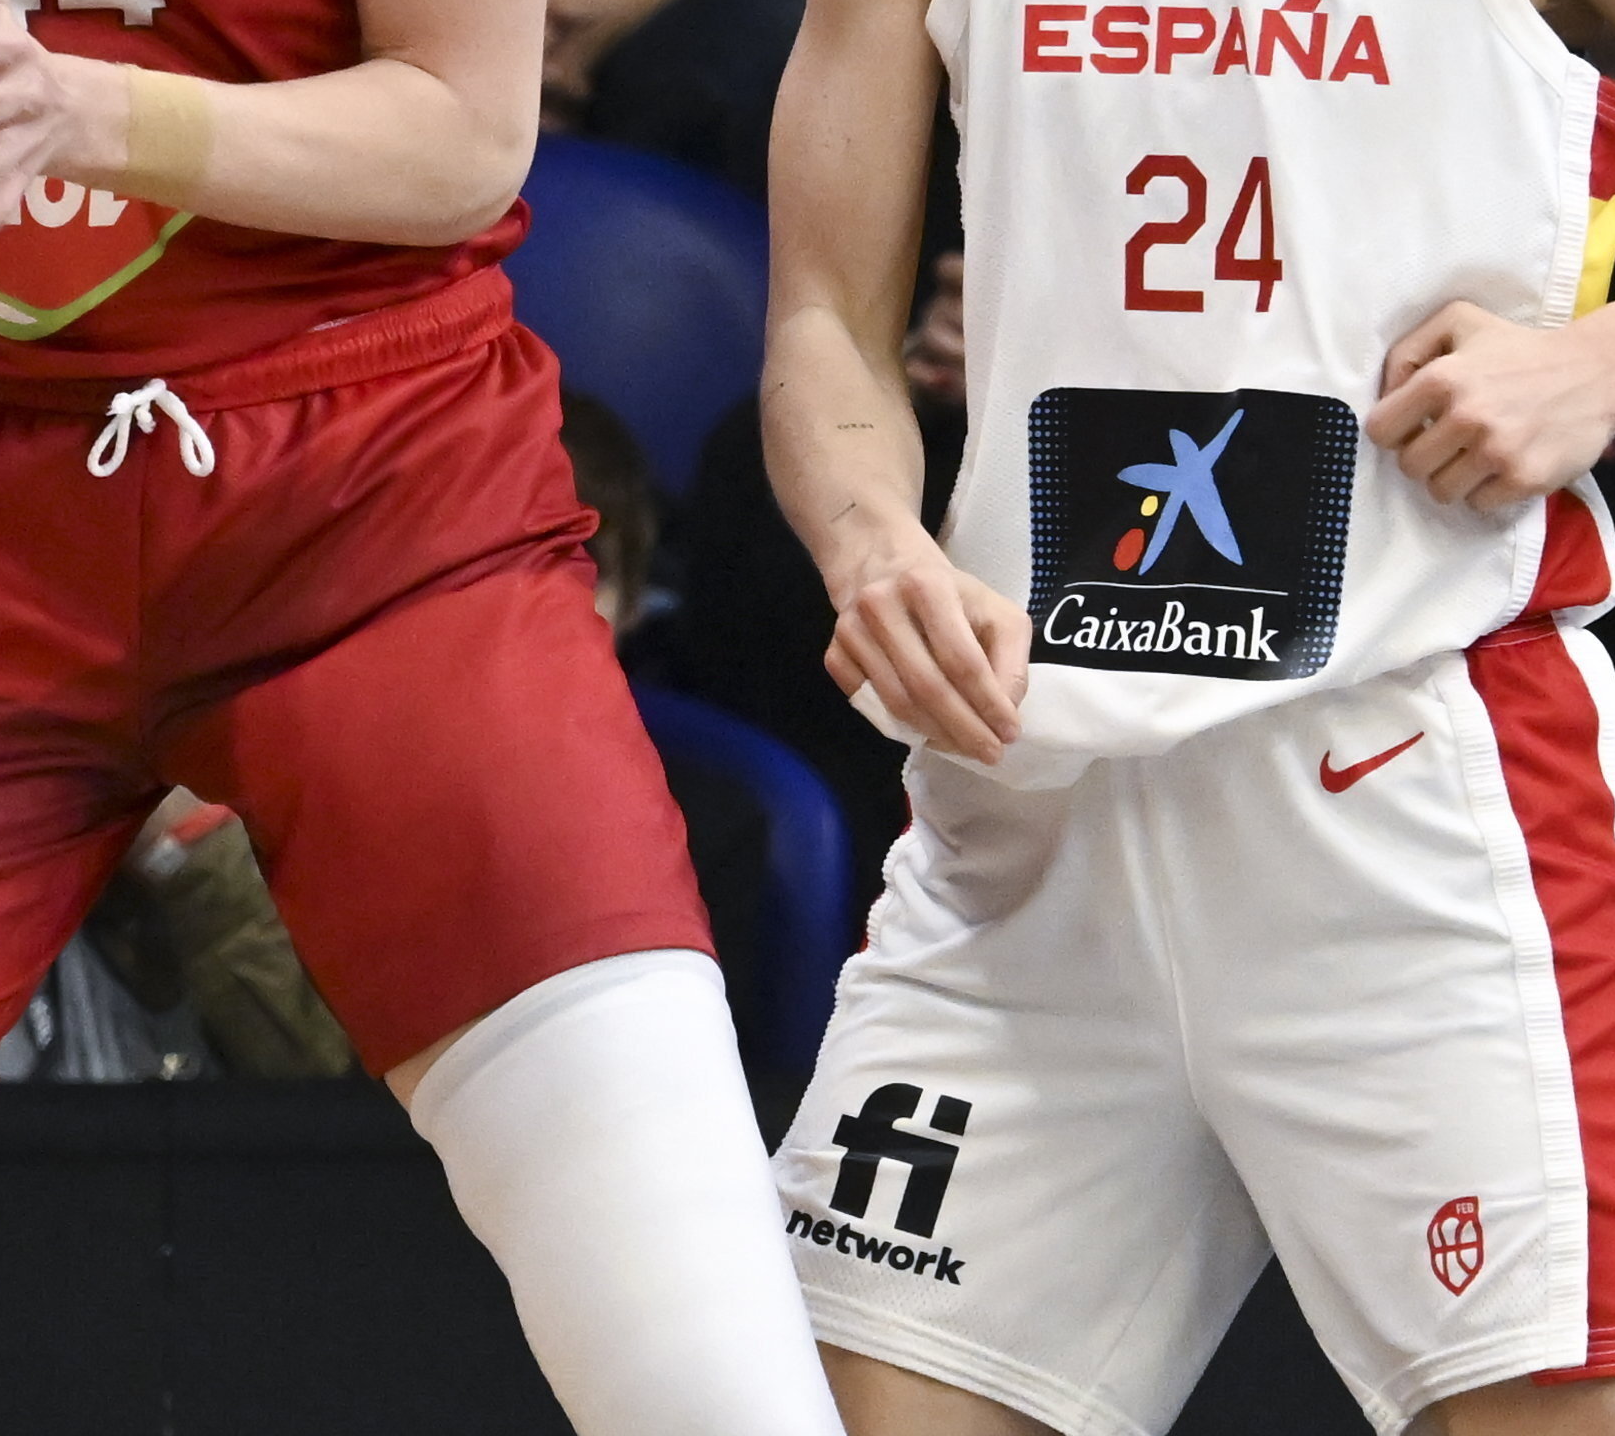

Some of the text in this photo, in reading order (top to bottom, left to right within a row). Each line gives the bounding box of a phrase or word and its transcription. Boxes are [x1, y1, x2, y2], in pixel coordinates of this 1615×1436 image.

[1124, 154, 1283, 313] 24
[1042, 594, 1281, 663] CaixaBank
[828, 1082, 973, 1240] fi
[785, 1209, 967, 1286] network
